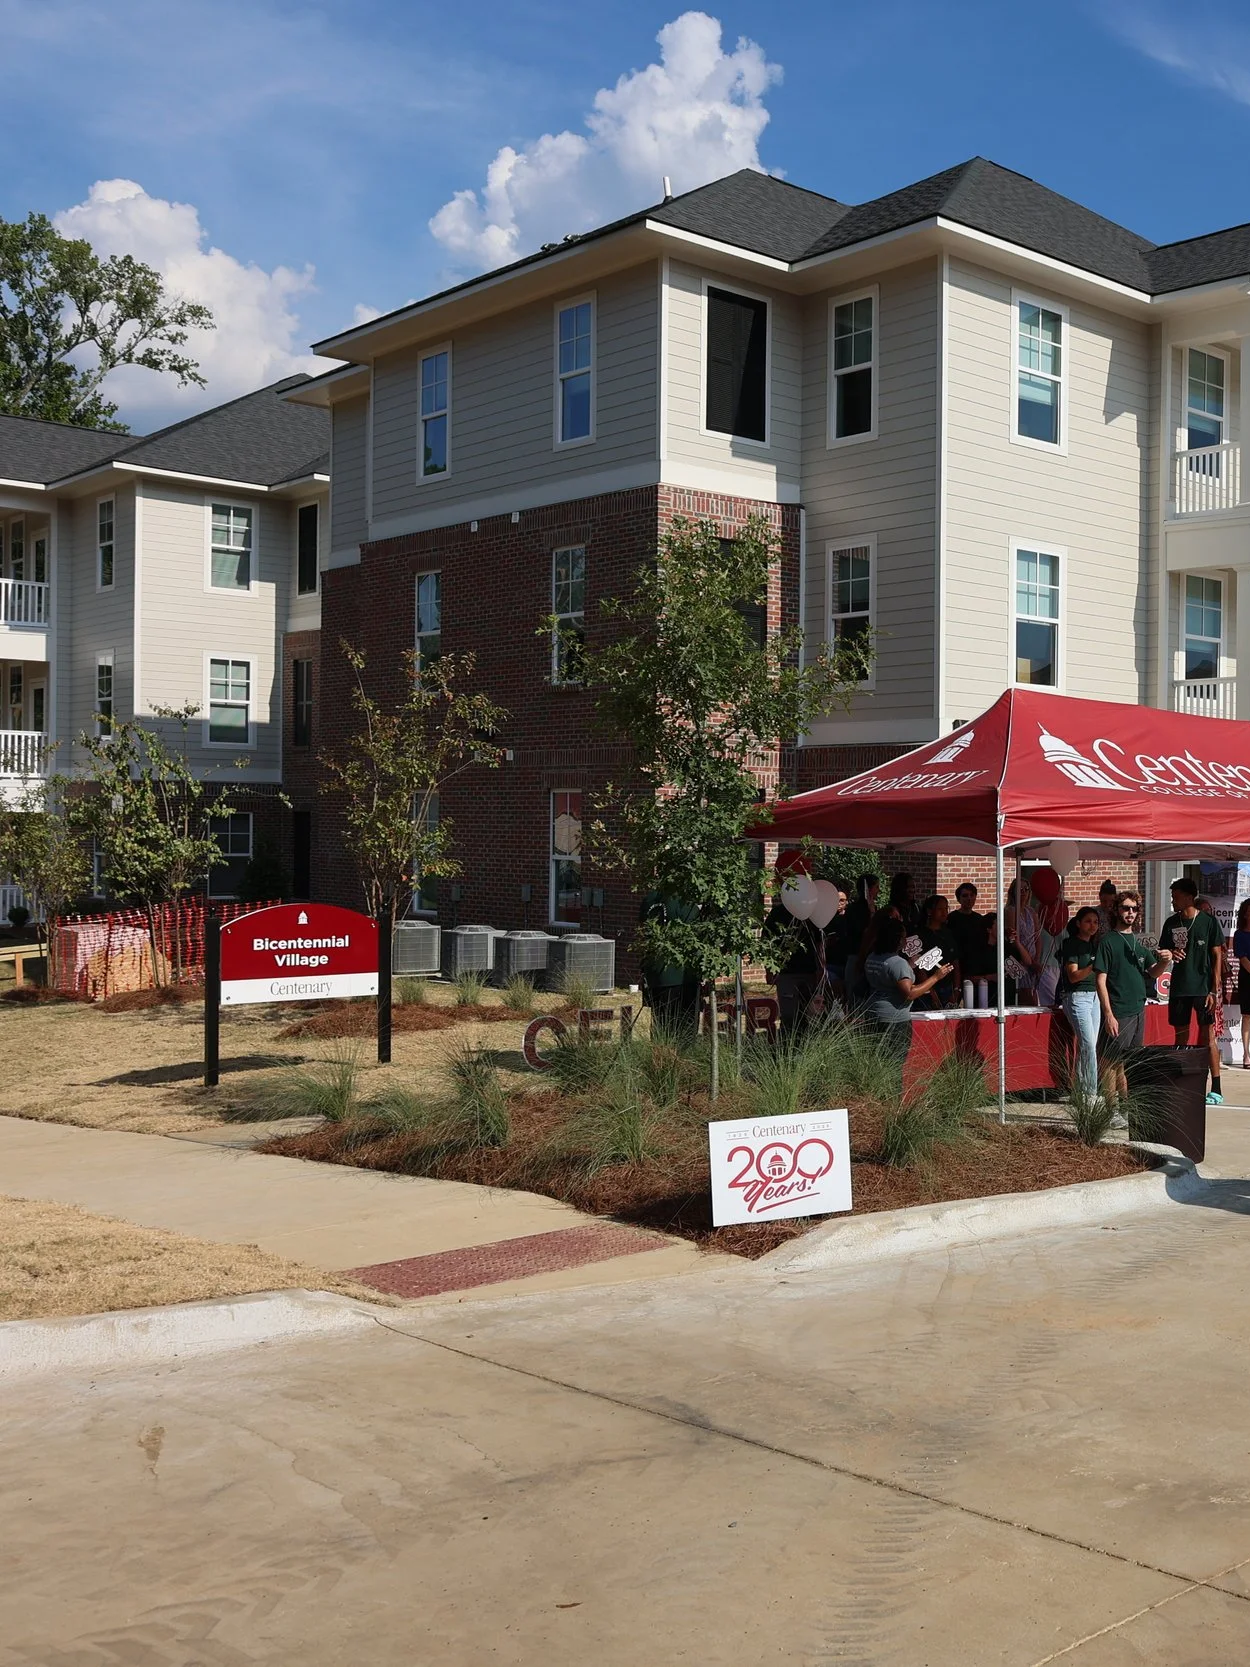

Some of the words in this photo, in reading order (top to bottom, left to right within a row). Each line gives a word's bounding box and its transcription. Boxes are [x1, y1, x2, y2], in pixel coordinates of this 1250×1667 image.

[837, 769, 989, 796] Centenary
[1139, 785, 1226, 798] COLLEGE
[253, 934, 349, 951] Bicentennial
[274, 953, 329, 968] Village
[270, 981, 333, 996] Centenary
[752, 1123, 807, 1138] Centenary
[727, 1138, 834, 1188] 200
[743, 1166, 823, 1213] Years!
